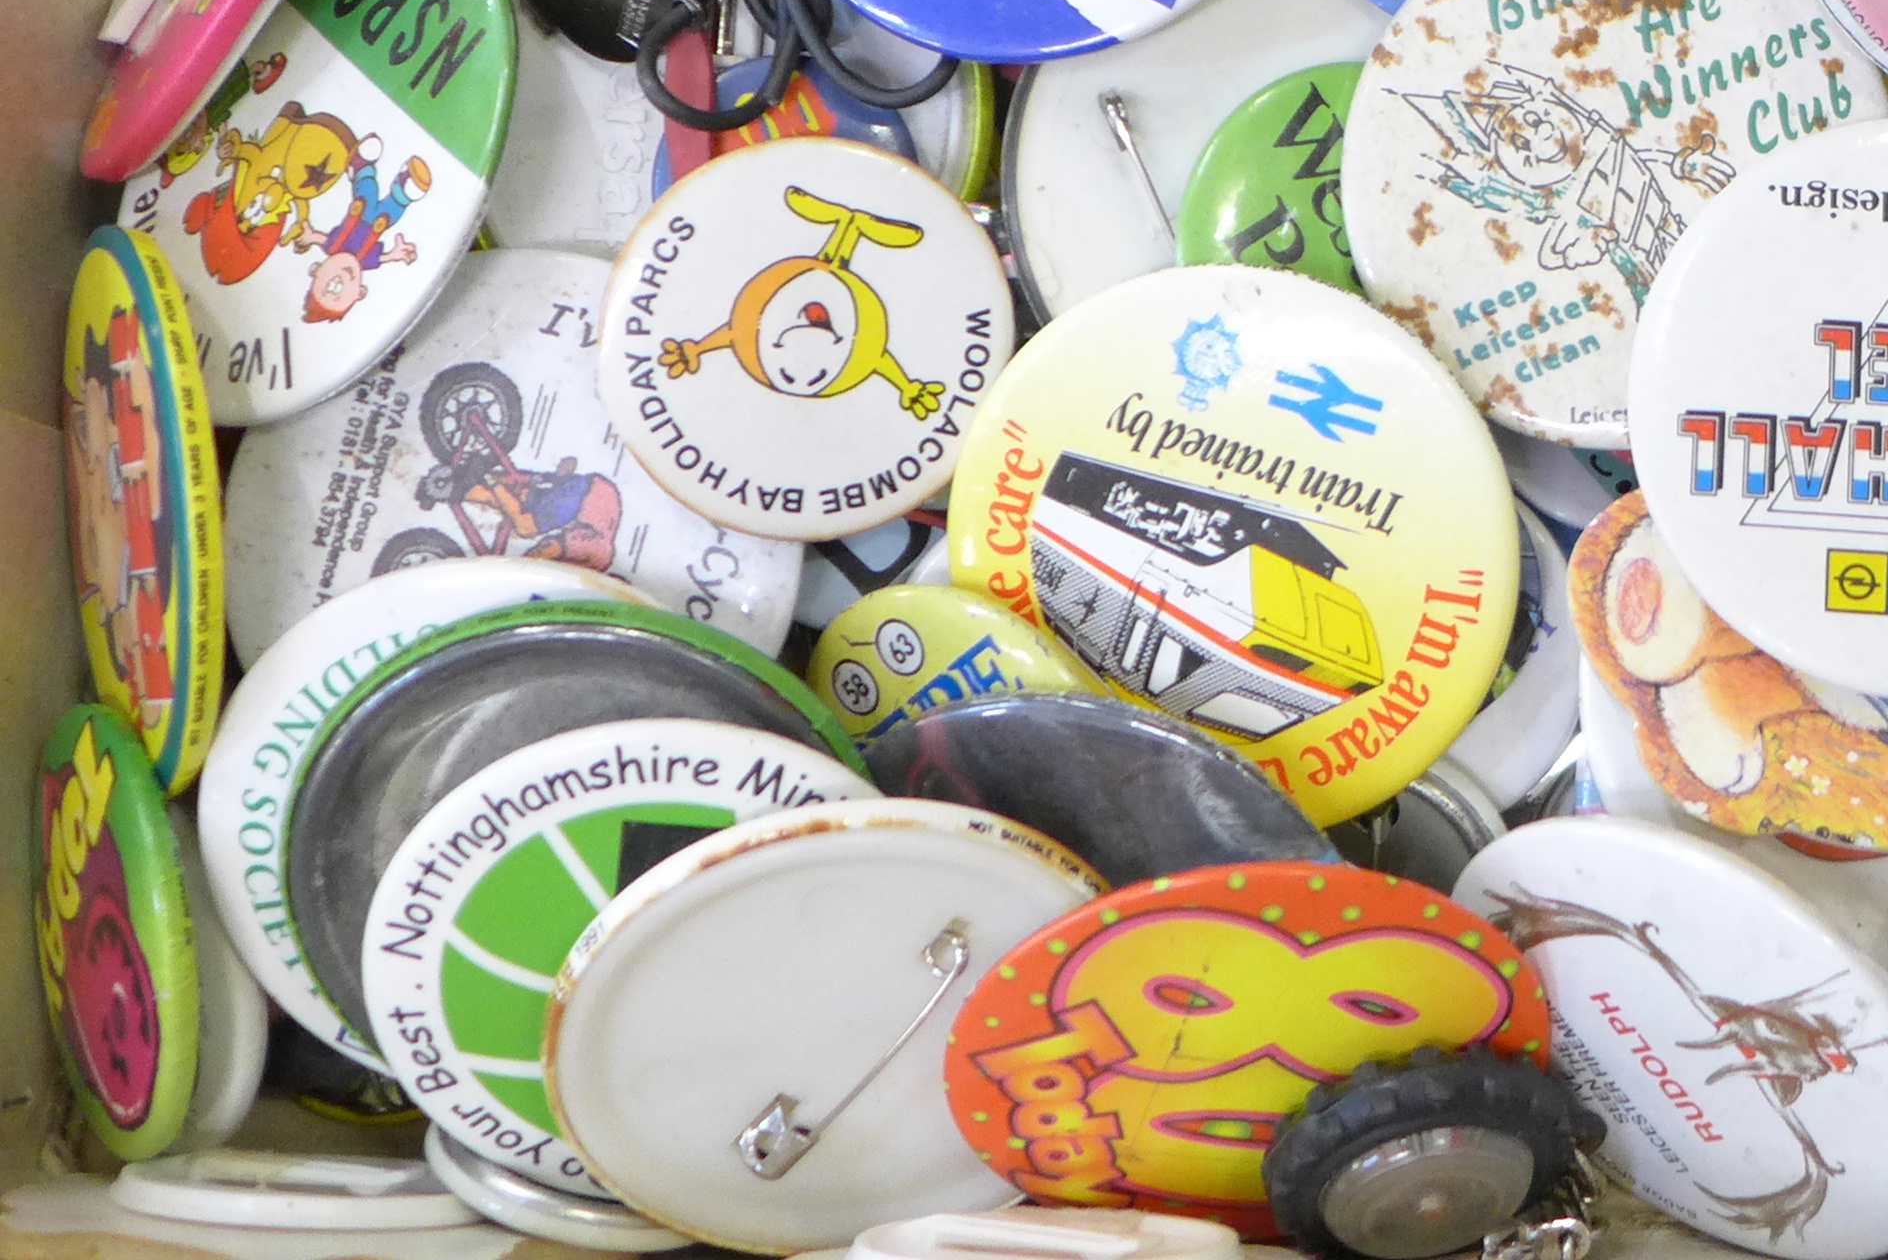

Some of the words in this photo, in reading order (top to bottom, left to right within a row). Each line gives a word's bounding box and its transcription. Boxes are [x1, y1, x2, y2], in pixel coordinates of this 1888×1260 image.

[1617, 17, 1832, 128] Winners
[1746, 69, 1853, 156] Club
[624, 214, 697, 337] PARCS
[1453, 281, 1537, 329] Keep
[227, 327, 294, 391] I've
[1453, 294, 1595, 370] Leicester
[624, 350, 729, 491] HOLIDAY
[820, 307, 992, 515] WOOLACOMBE
[1105, 390, 1156, 458] by
[1149, 420, 1297, 493] trained
[350, 501, 378, 552] Group
[726, 481, 805, 515] BAY
[1298, 466, 1405, 537] Train
[888, 630, 917, 662] 63
[841, 673, 871, 704] 58
[1297, 668, 1432, 789] aware
[380, 743, 721, 962] Nottinghamshire
[386, 1008, 459, 1095] Best
[1589, 992, 1724, 1143] RUDOLPH
[450, 1103, 555, 1168] your
[1603, 1079, 1690, 1175] LEICESTER
